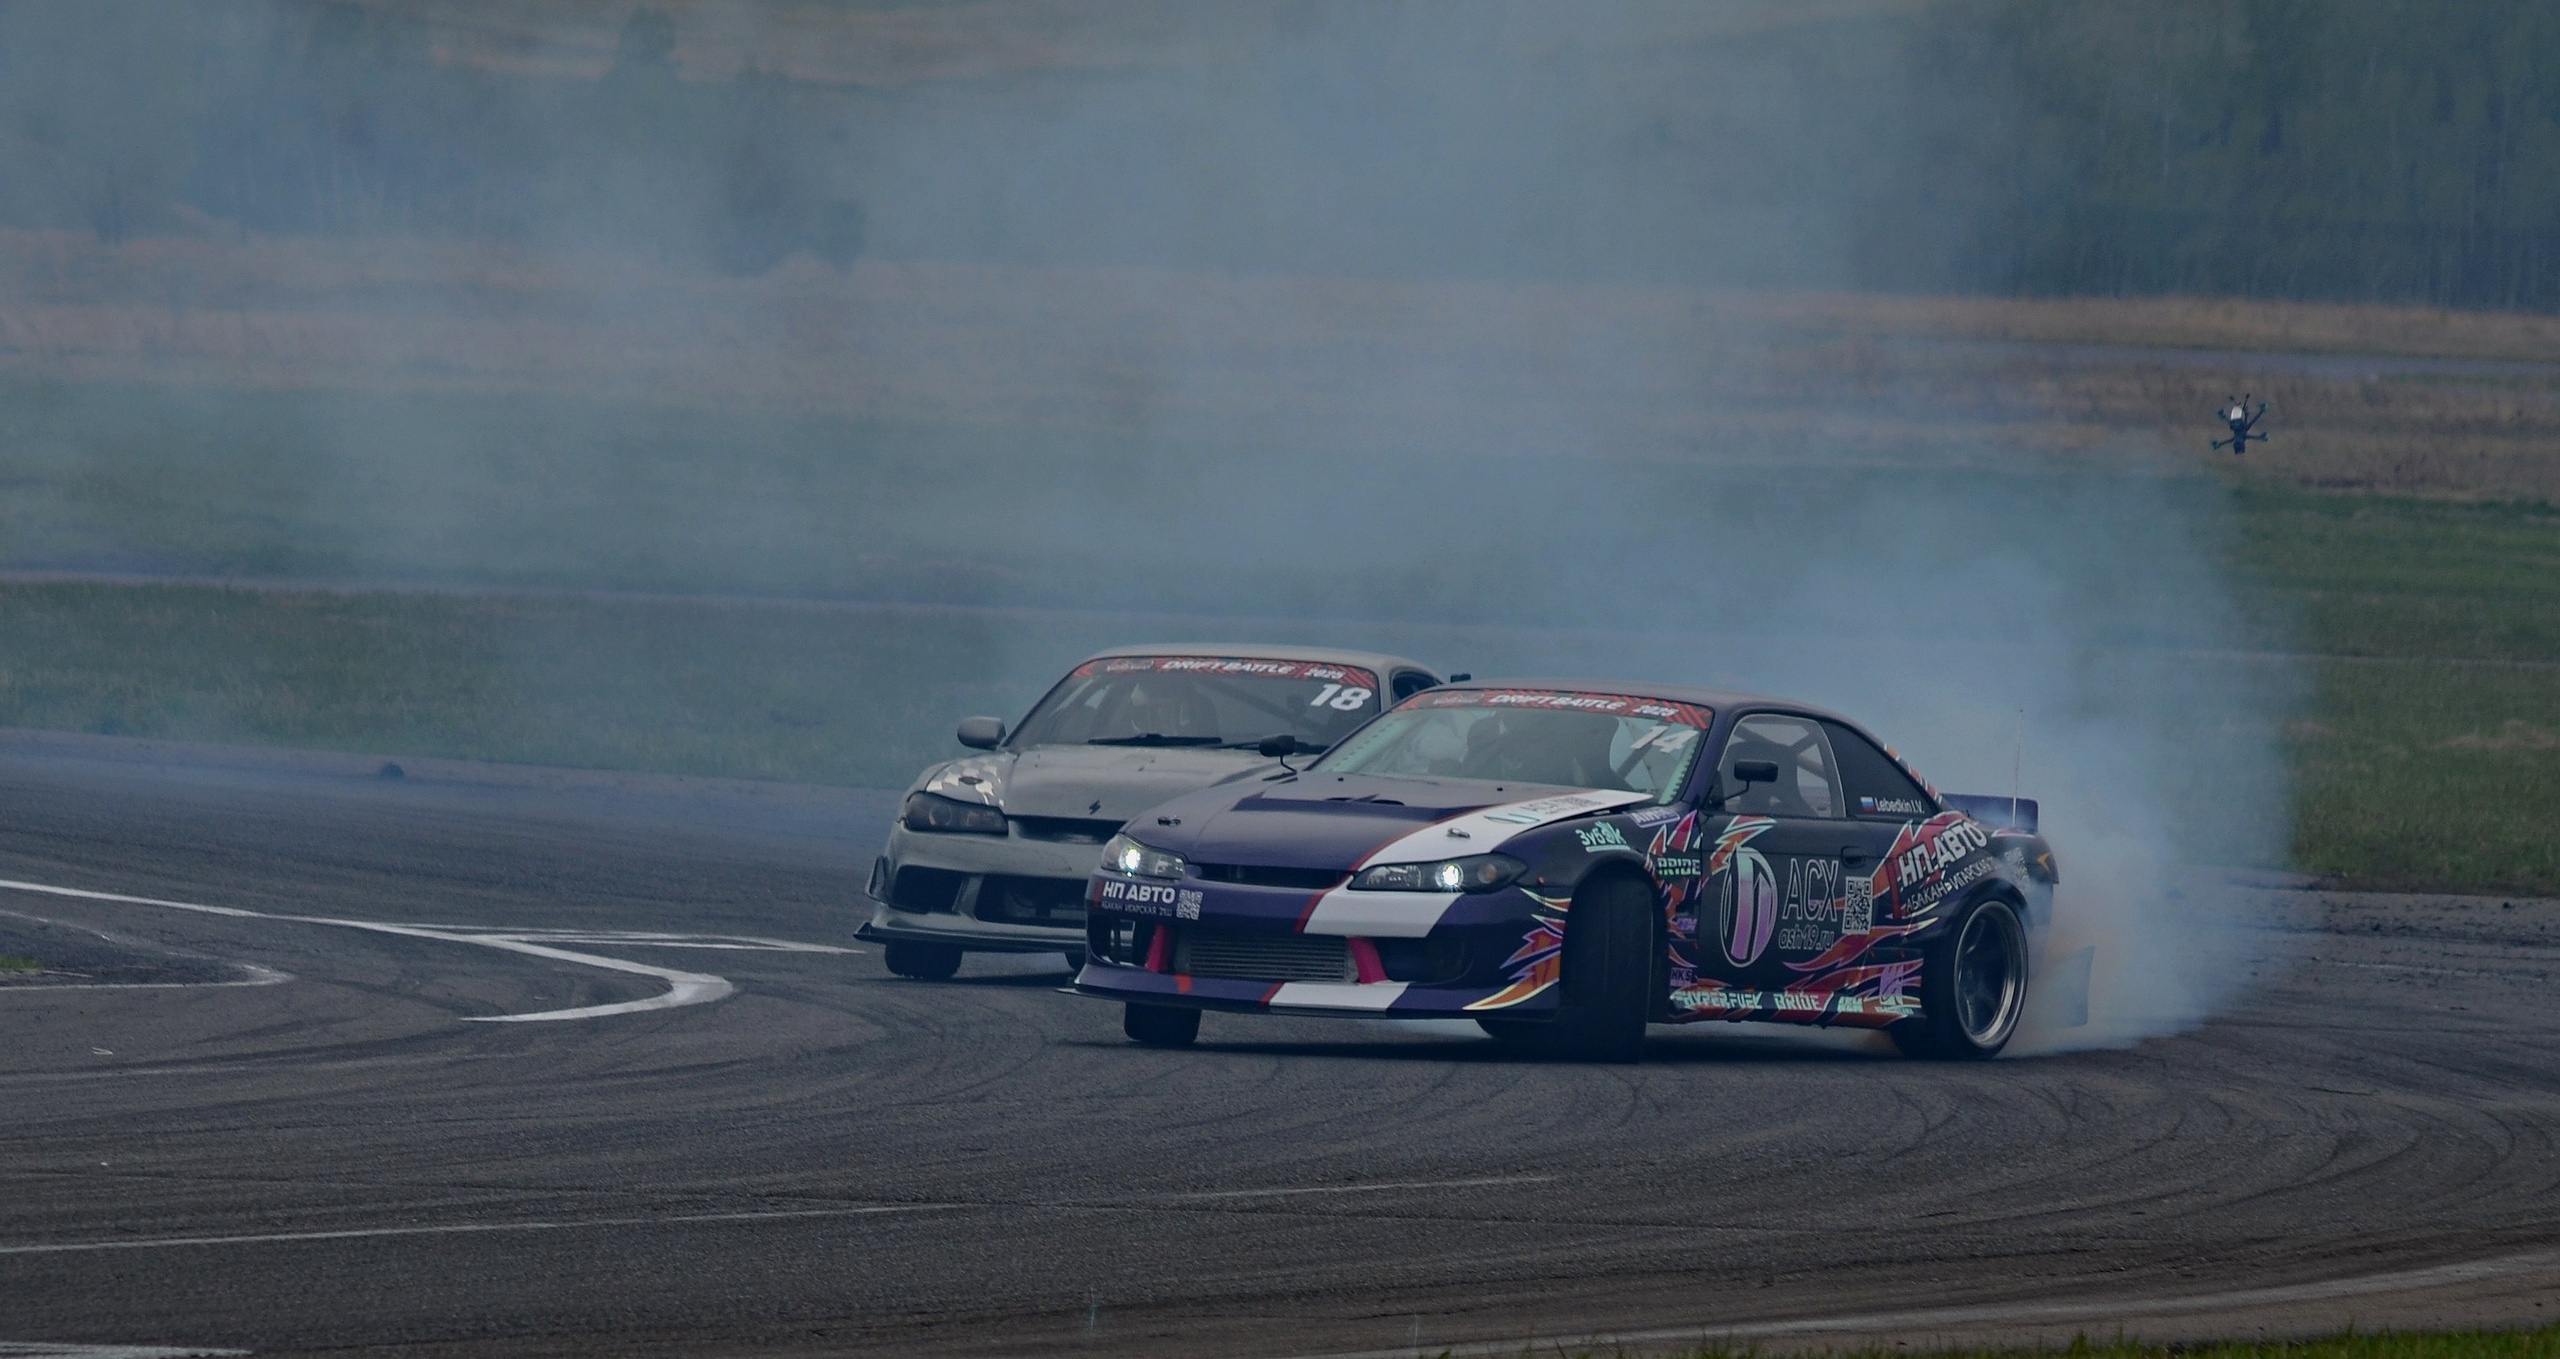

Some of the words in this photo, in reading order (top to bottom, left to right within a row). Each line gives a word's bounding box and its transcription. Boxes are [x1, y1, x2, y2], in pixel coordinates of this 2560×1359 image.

[1161, 660, 1226, 670] DRIFT
[1222, 661, 1296, 674] BATTLE
[1304, 668, 1346, 679] 2025
[1310, 684, 1372, 711] 18
[1630, 725, 1699, 753] 14
[1874, 797, 1912, 813] Lebedkin
[1932, 821, 1988, 868] АВТО
[1102, 881, 1125, 899] НП
[1126, 884, 1176, 904] АВТО
[1906, 880, 1948, 913] АБАКАН
[1779, 924, 1835, 951] ash19.ru
[1672, 968, 1692, 982] HKS
[1773, 991, 1822, 1011] BRIDE
